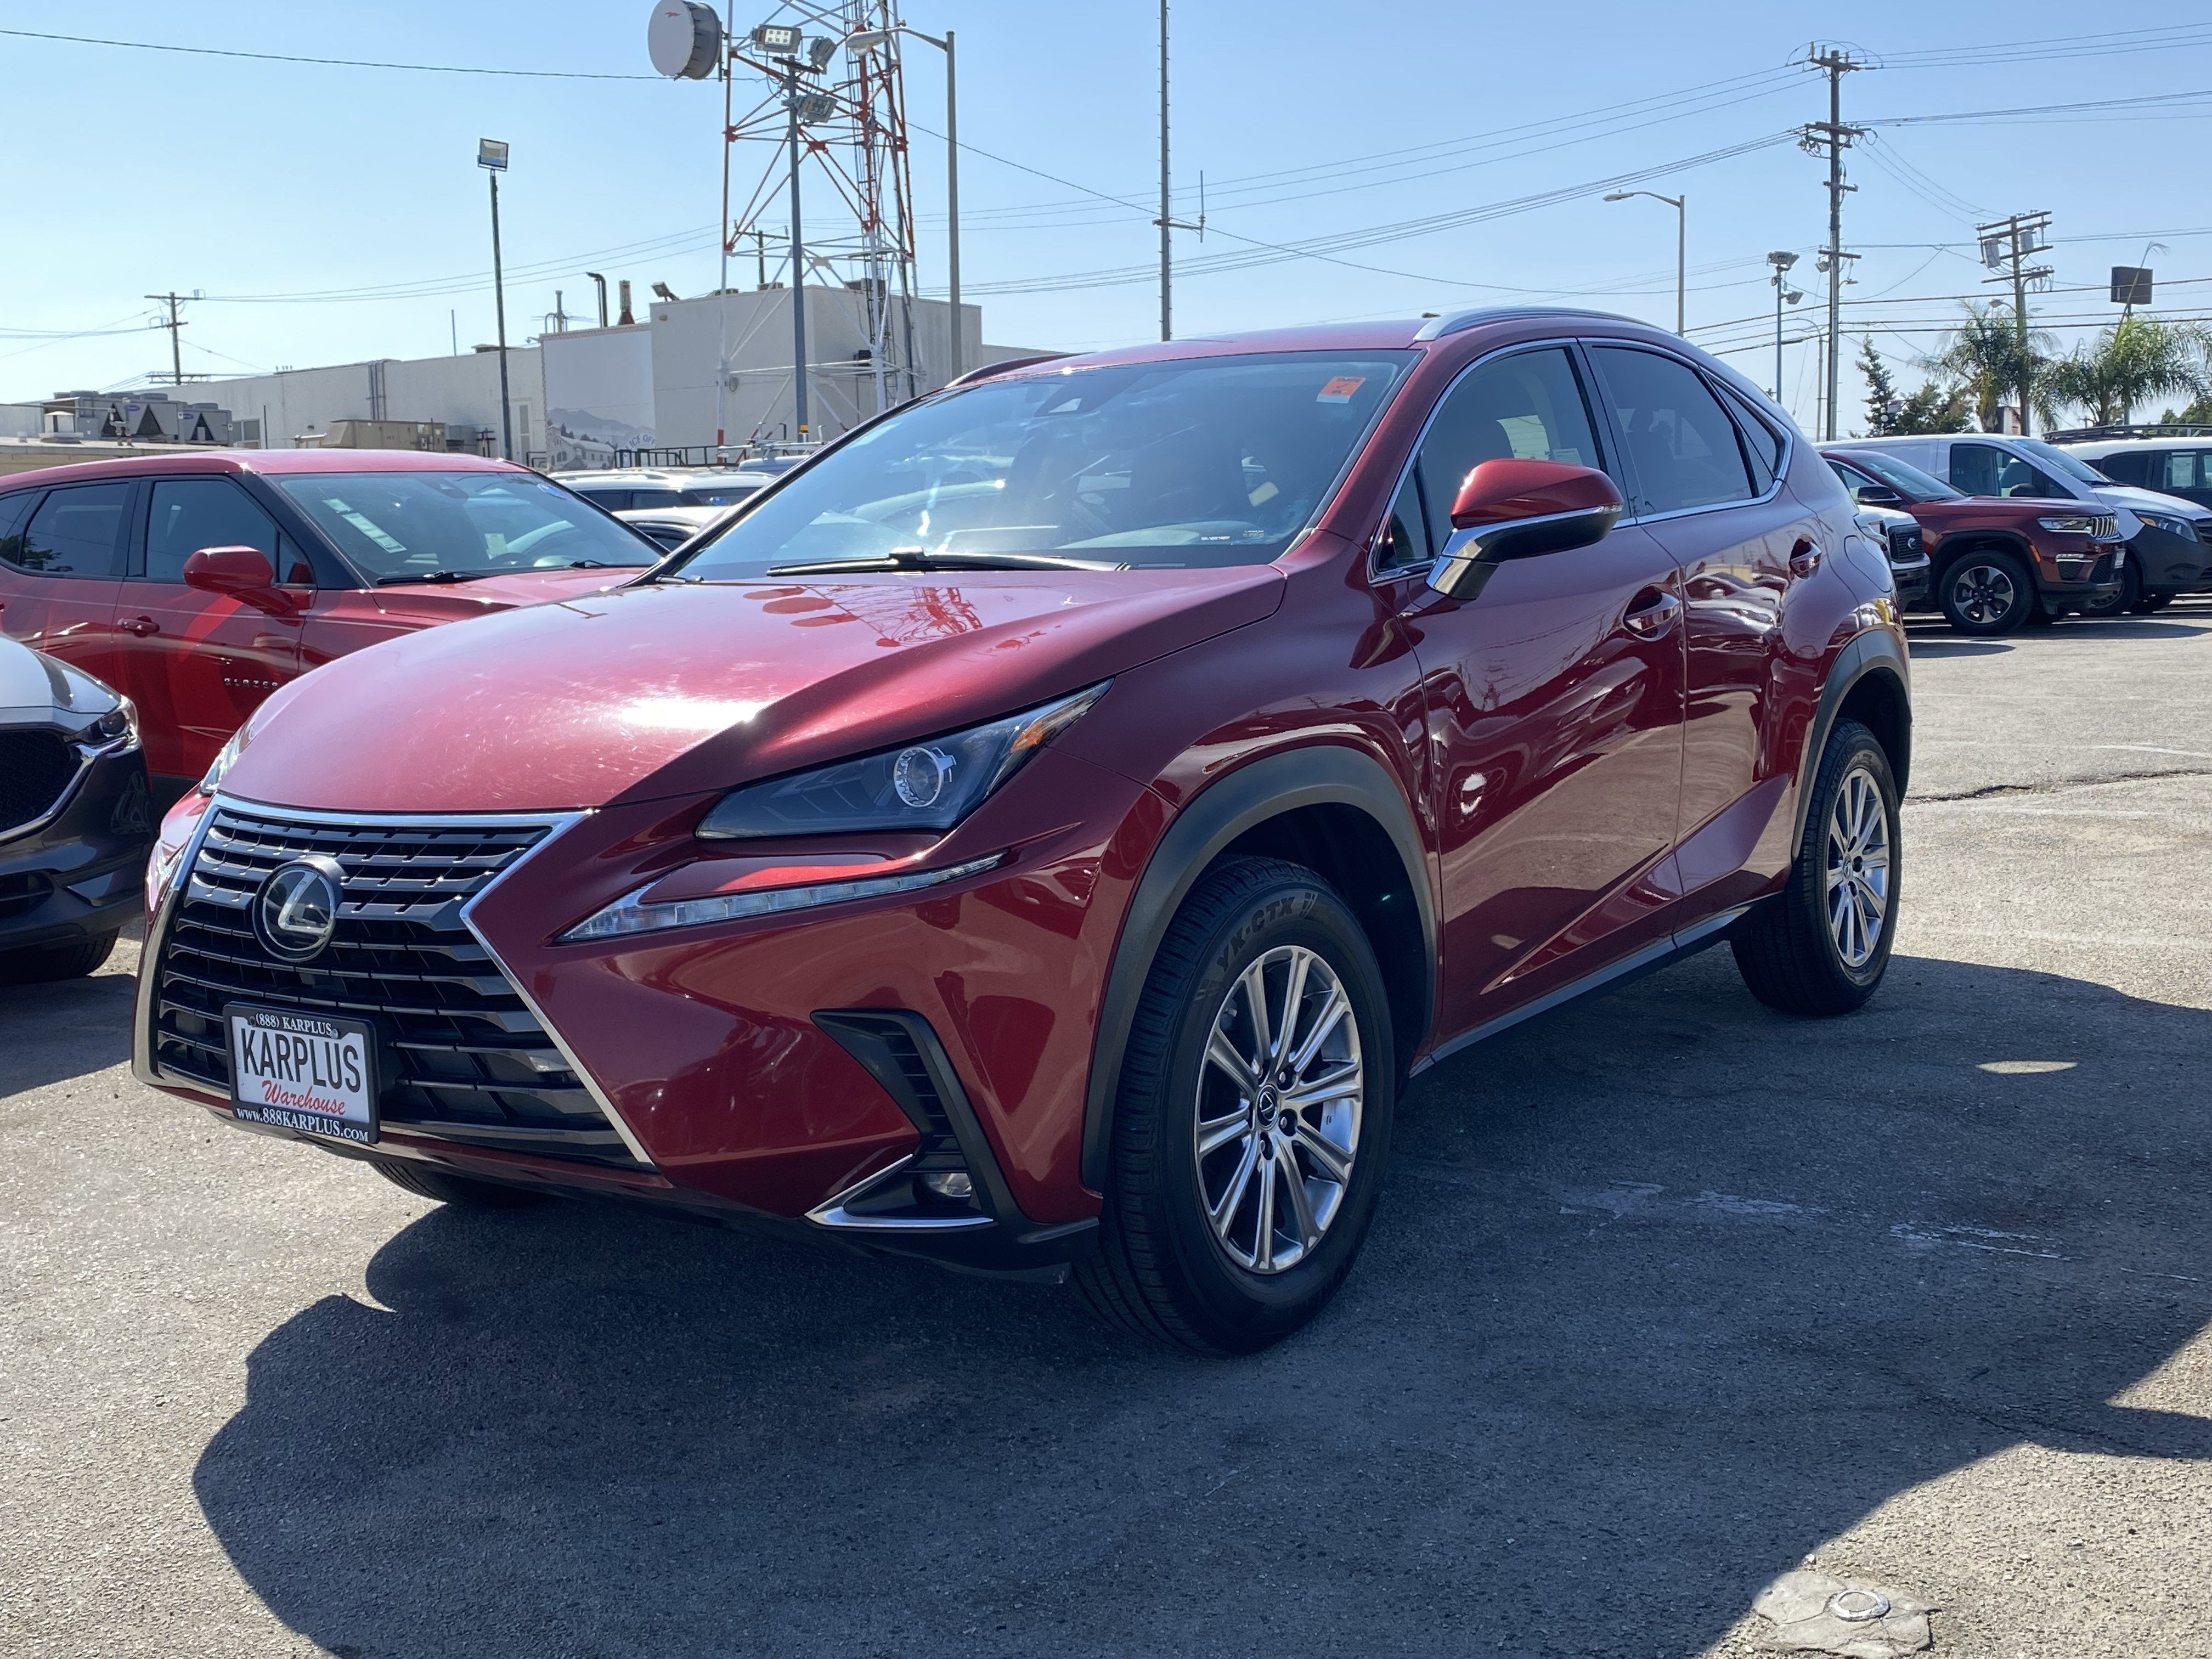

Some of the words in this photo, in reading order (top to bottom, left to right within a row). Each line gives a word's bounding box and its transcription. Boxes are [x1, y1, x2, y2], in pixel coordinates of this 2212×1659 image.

[255, 1012, 280, 1028] (888)
[282, 1016, 332, 1036] KARPLUS
[241, 1028, 360, 1093] KARPLUS
[262, 1080, 346, 1115] Warehouse
